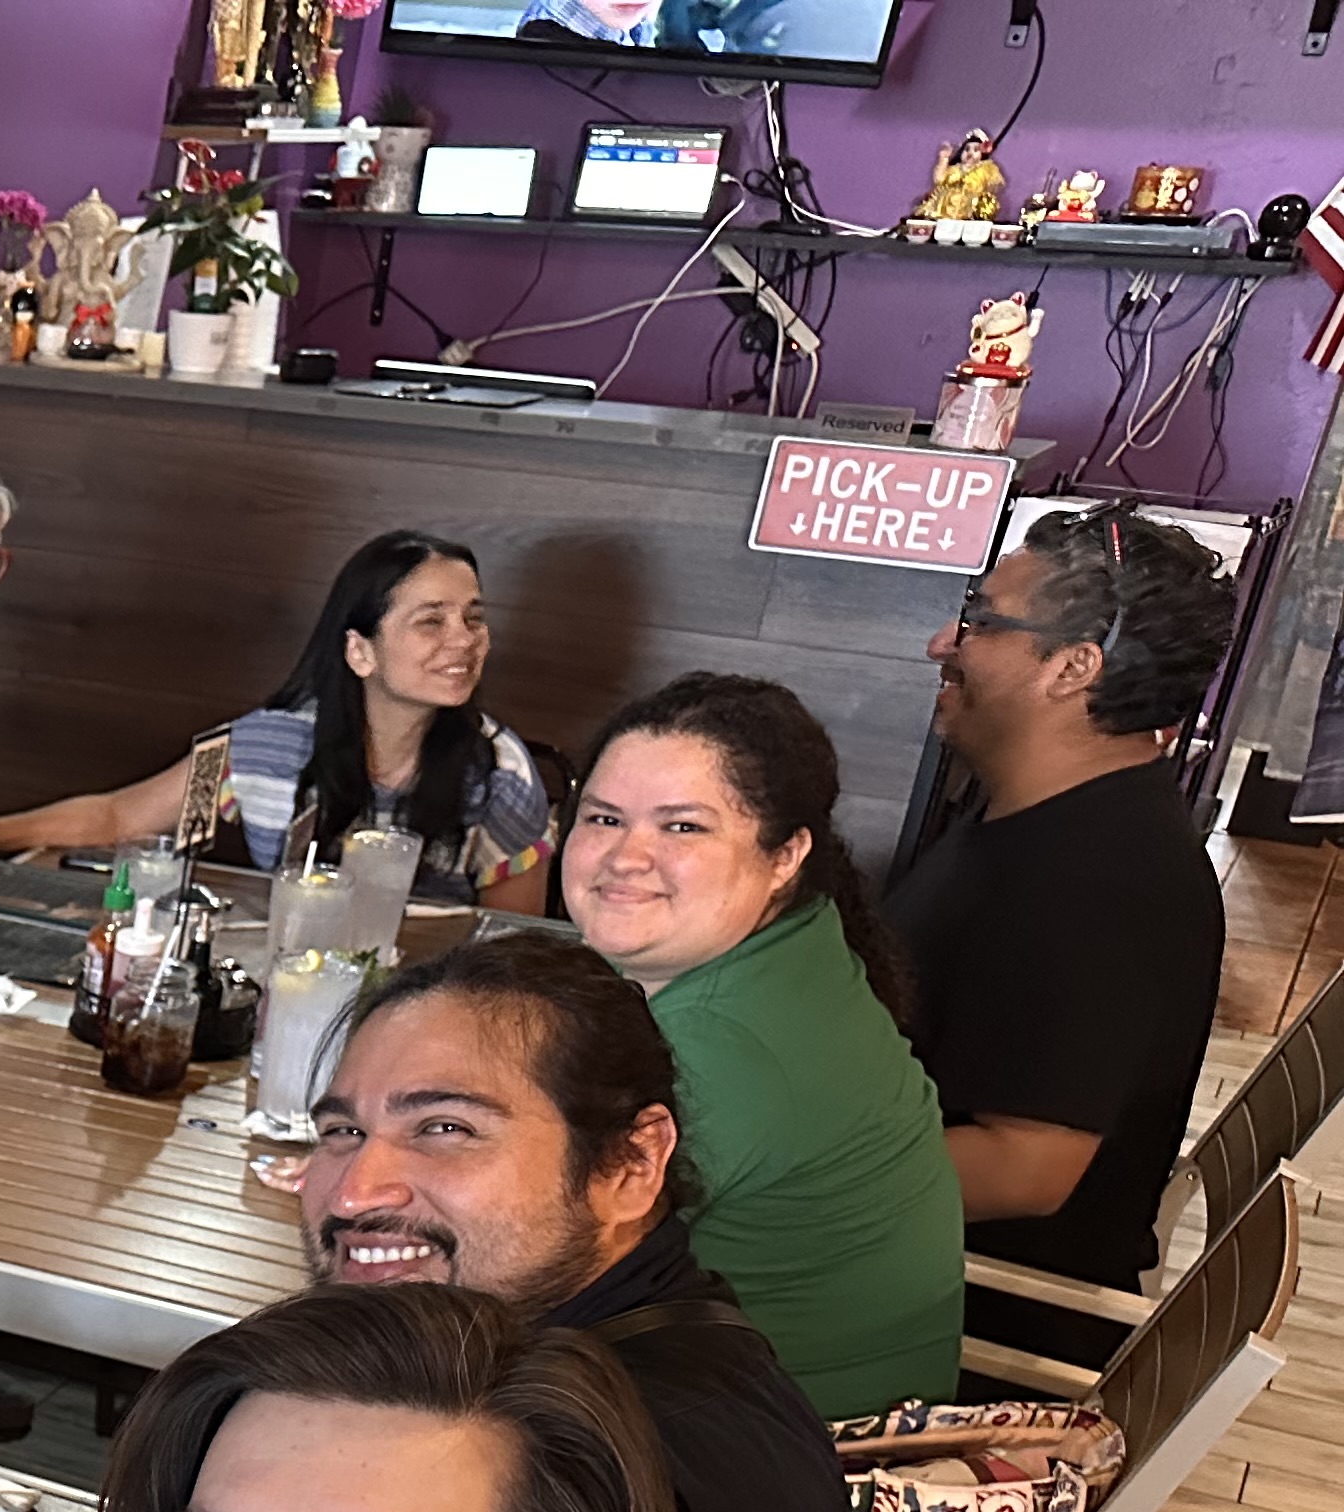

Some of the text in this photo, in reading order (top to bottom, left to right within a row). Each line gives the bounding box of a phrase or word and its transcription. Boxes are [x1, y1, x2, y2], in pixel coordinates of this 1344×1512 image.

[822, 413, 905, 434] Reserved
[780, 454, 993, 510] PICK-UP
[811, 502, 938, 551] HERE
